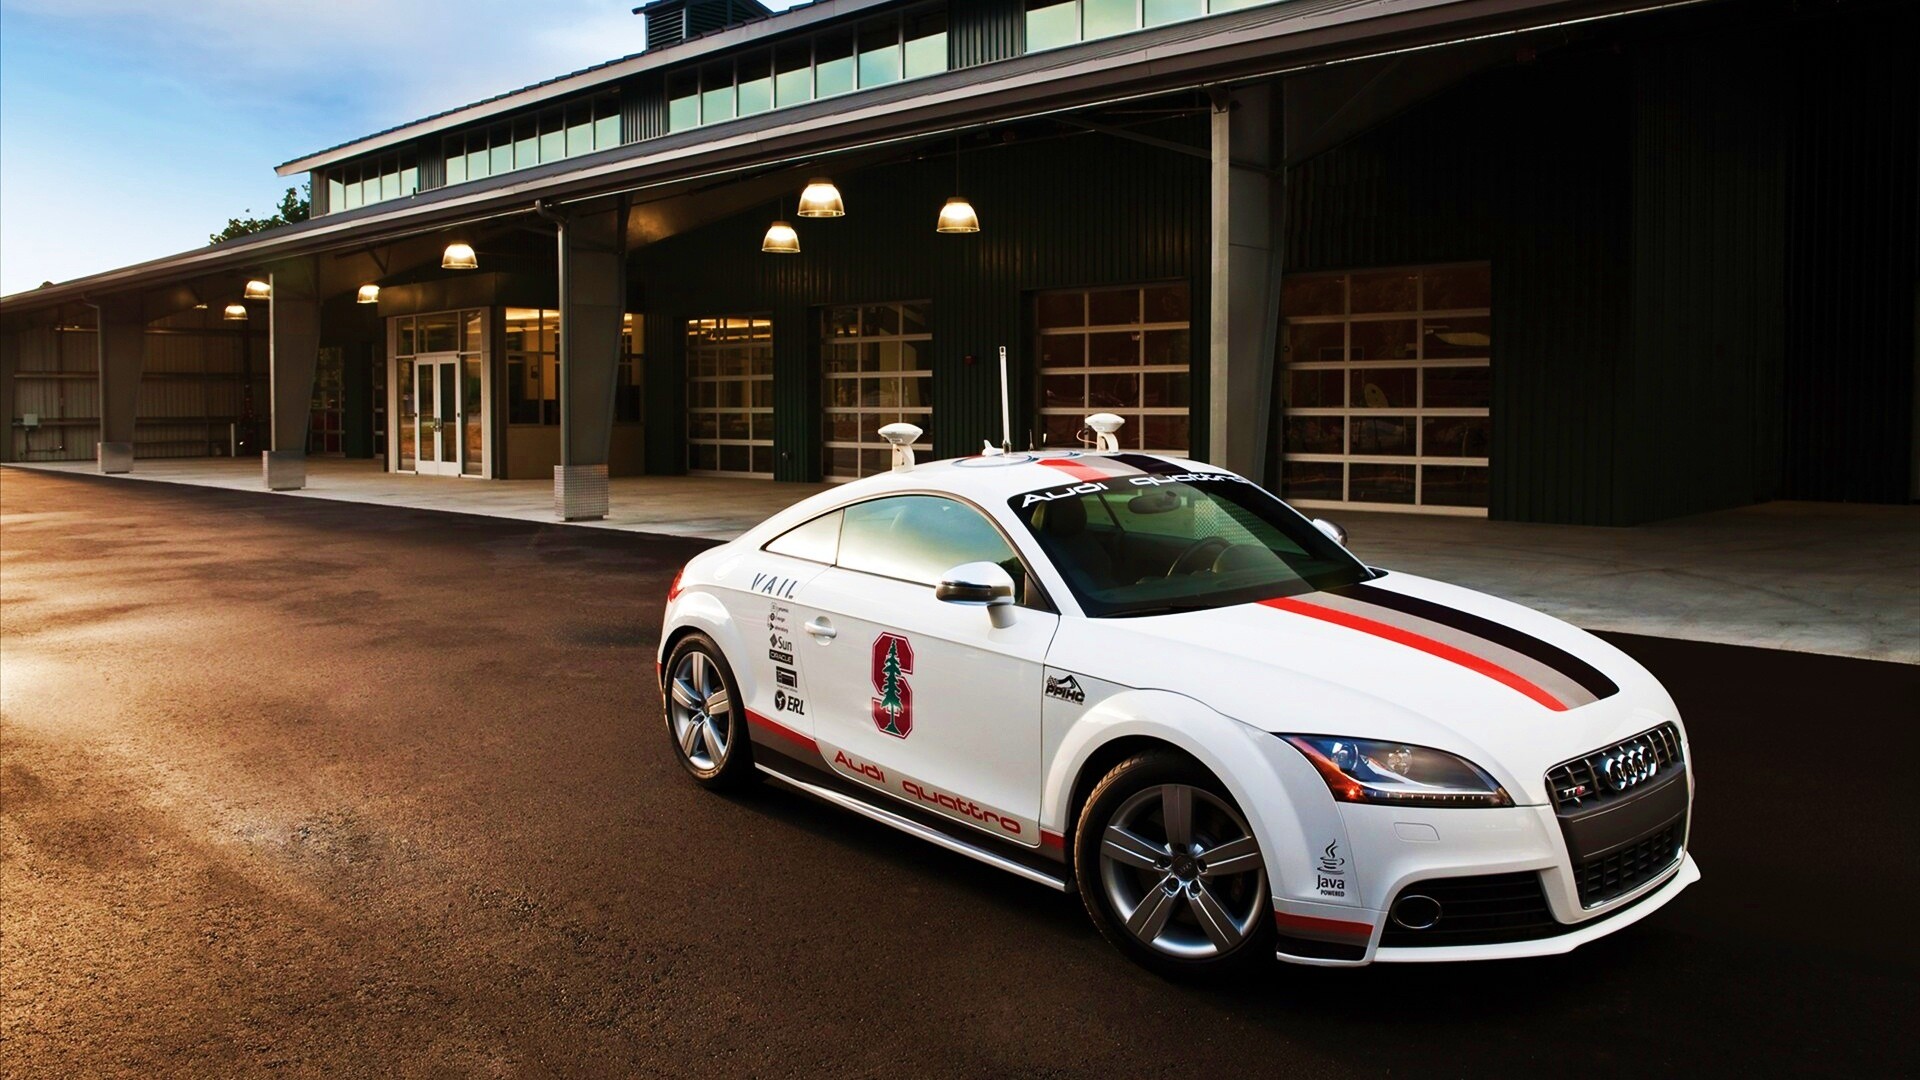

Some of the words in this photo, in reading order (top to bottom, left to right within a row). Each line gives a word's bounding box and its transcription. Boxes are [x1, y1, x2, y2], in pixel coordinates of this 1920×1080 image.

[1022, 482, 1109, 508] Audi
[777, 636, 793, 652] Sun
[770, 651, 793, 664] ORACLE
[1045, 684, 1085, 703] PPIHC
[787, 695, 805, 716] ERL
[834, 750, 886, 783] Audi
[902, 780, 1022, 835] quattro
[1563, 785, 1586, 797] TTS
[1316, 874, 1345, 890] Java
[1320, 889, 1345, 897] POWERED
